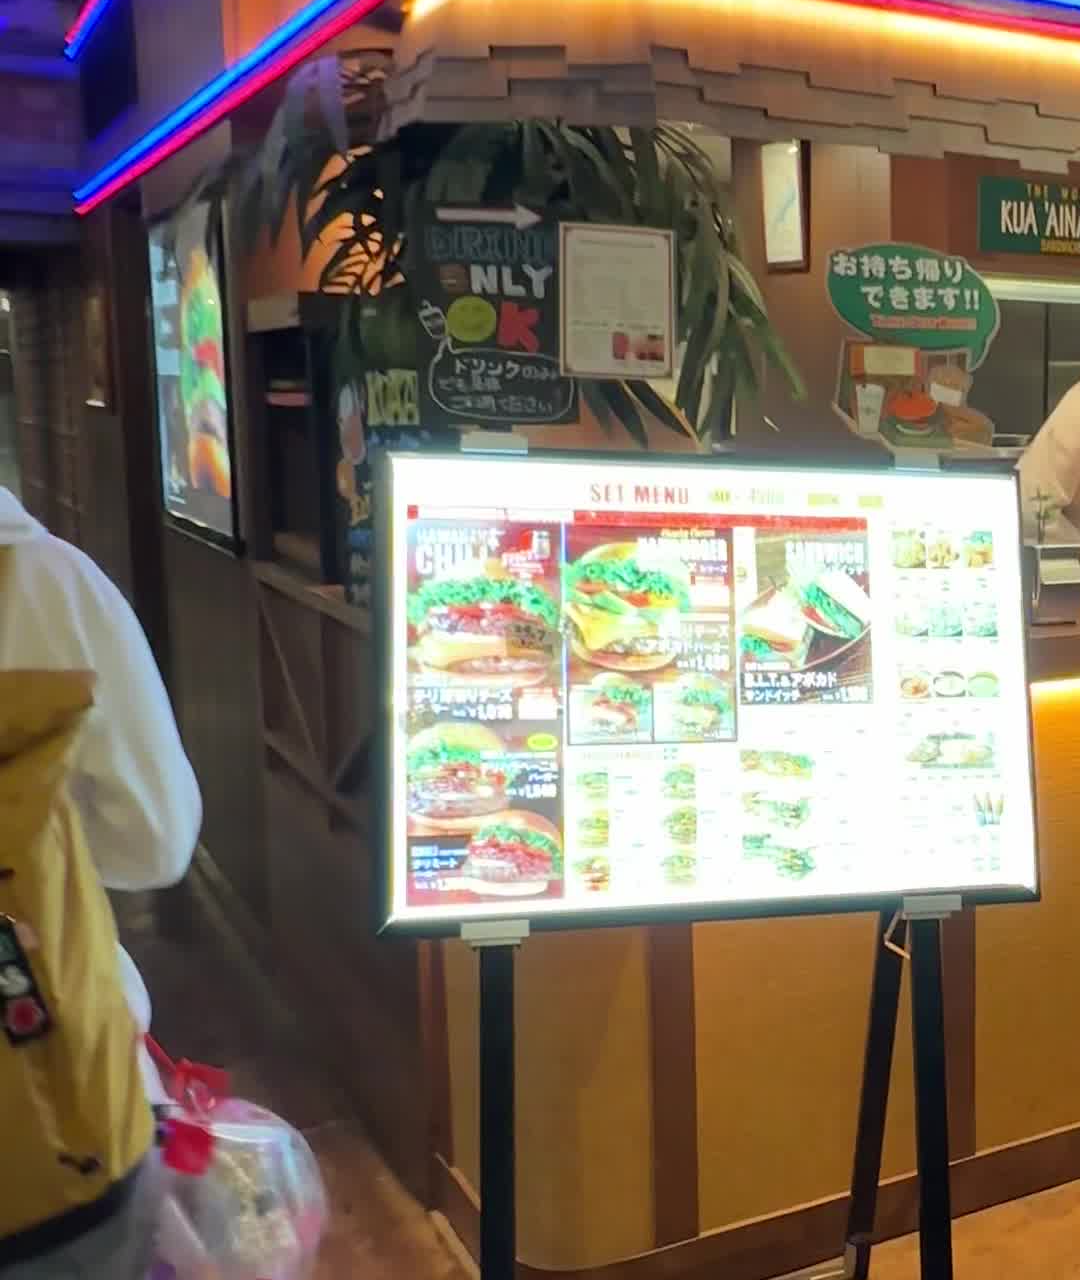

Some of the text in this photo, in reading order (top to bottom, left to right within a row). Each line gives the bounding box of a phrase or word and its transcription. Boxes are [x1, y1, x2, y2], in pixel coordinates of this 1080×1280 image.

[1000, 200, 1038, 236] KUA
[832, 252, 963, 283] お持ち帰り
[633, 484, 690, 505] MENU
